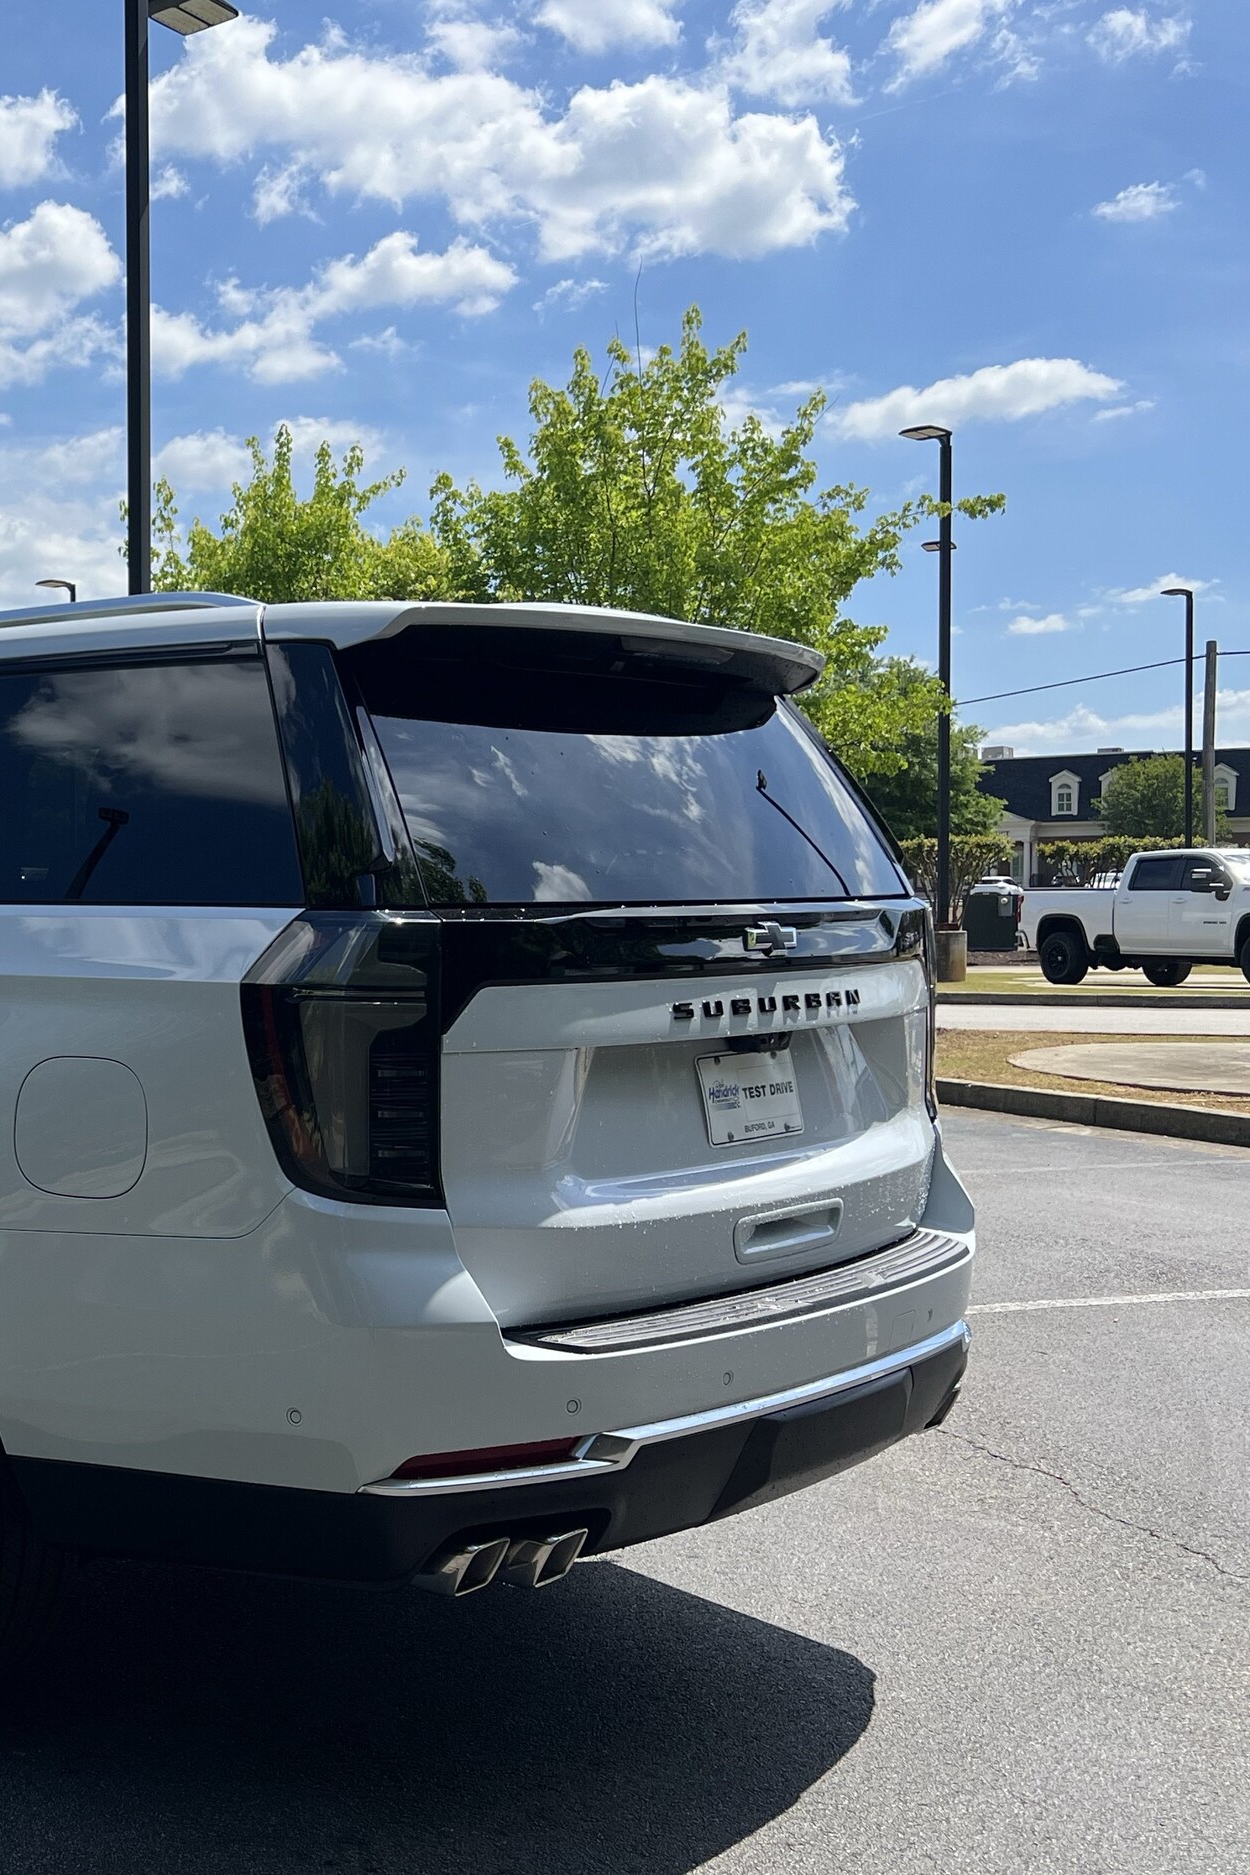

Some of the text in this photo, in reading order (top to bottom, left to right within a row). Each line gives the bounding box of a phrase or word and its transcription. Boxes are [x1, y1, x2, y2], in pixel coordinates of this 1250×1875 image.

[672, 989, 861, 1020] SUBURBAN
[742, 1081, 794, 1099] TEST DRIVE
